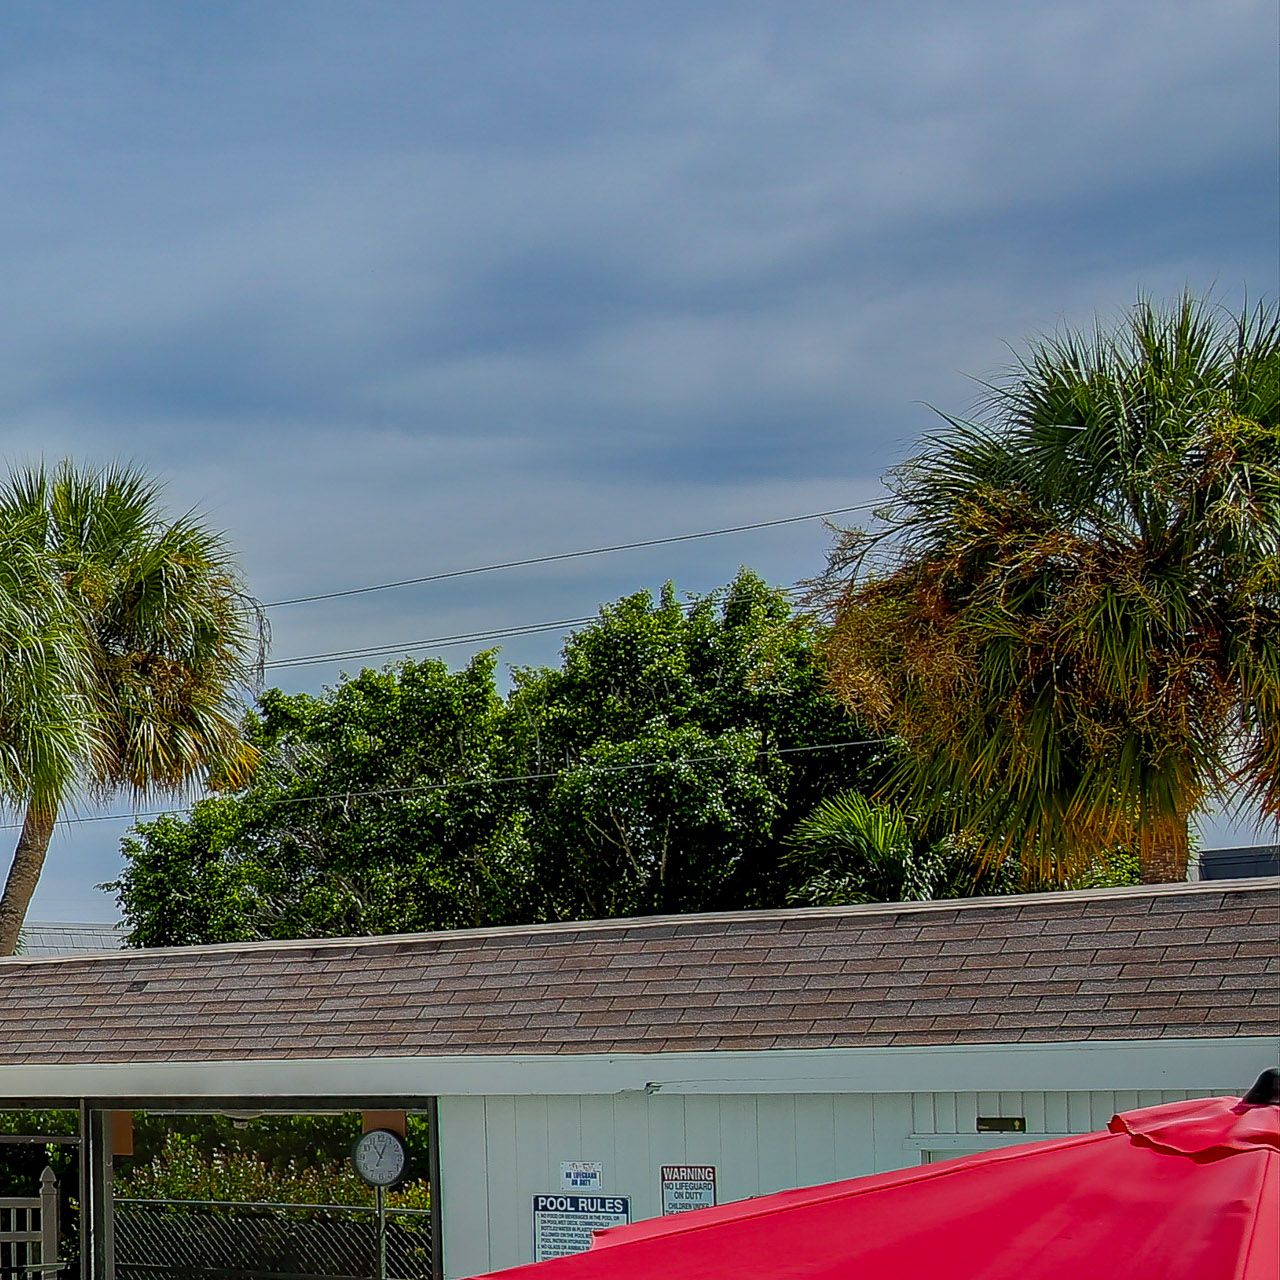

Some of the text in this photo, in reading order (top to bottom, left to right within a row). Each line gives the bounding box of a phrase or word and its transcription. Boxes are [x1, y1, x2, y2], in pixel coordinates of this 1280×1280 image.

[663, 1168, 713, 1180] WARNING
[664, 1182, 712, 1190] NO LIFEGUARD
[674, 1191, 703, 1199] ON DUTY
[538, 1197, 623, 1212] POOL RULES
